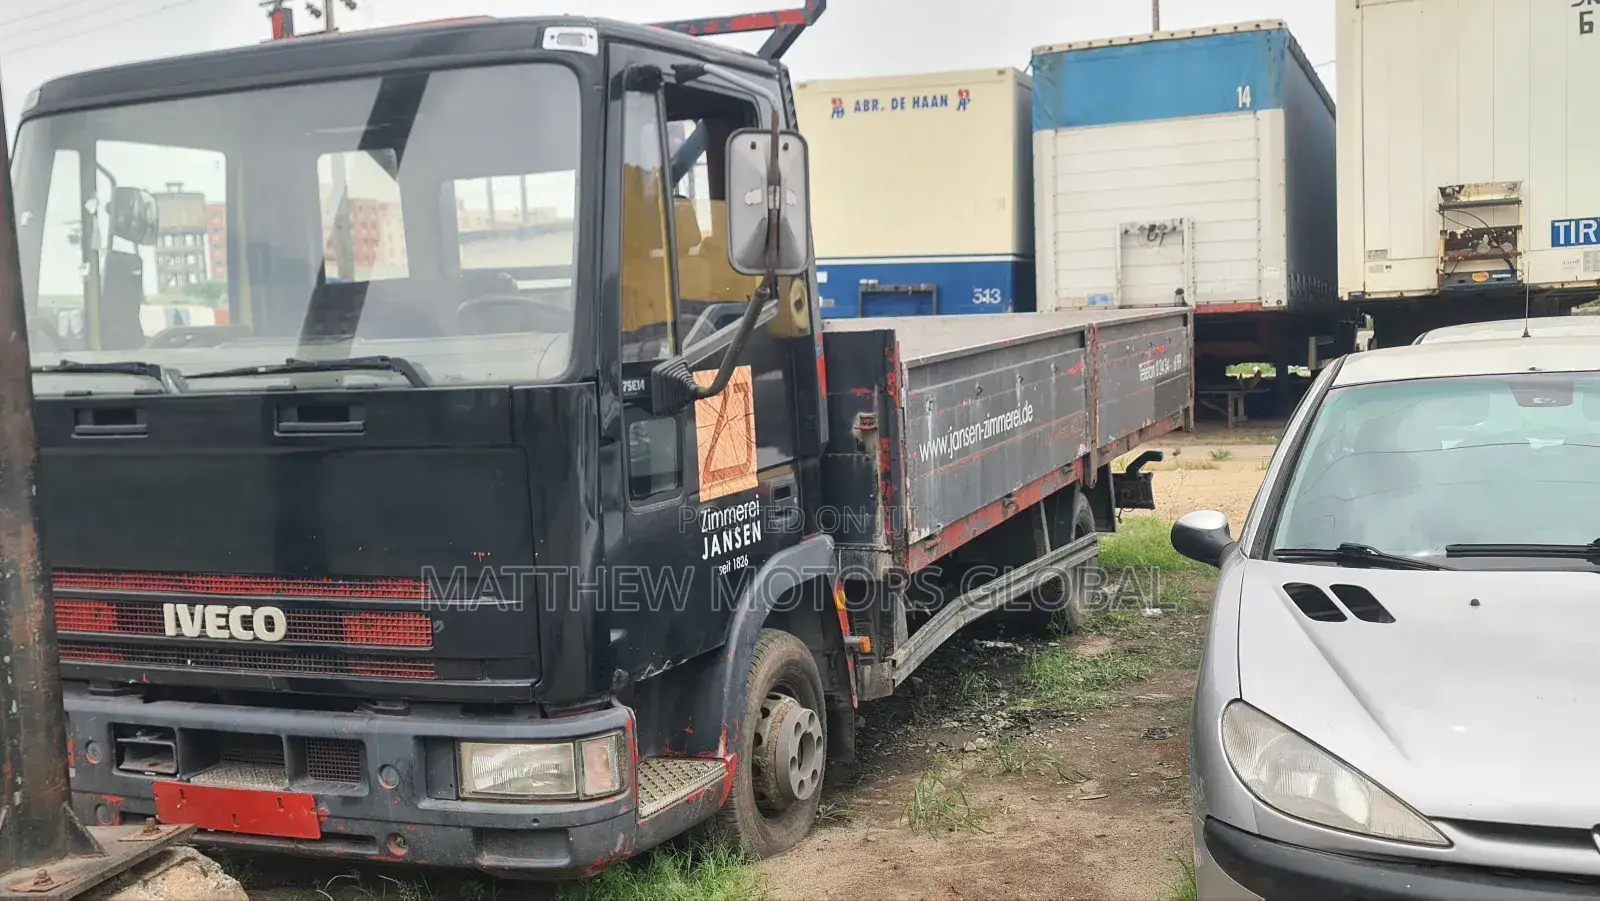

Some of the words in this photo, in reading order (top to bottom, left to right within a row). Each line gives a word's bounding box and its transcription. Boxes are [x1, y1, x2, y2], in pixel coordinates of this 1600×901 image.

[853, 99, 885, 113] ABR.
[891, 97, 906, 110] DE
[912, 95, 948, 109] HAAN
[1236, 85, 1251, 108] 14
[1554, 219, 1598, 245] TIR
[972, 288, 1002, 304] 513
[622, 379, 645, 392] 75E14
[919, 400, 1034, 463] www.jansen-zimmerei.de
[701, 494, 760, 533] Zimmerei
[702, 520, 762, 560] JANSEN
[719, 561, 732, 575] seit
[733, 554, 749, 570] 1826
[163, 603, 287, 641] IVECO
